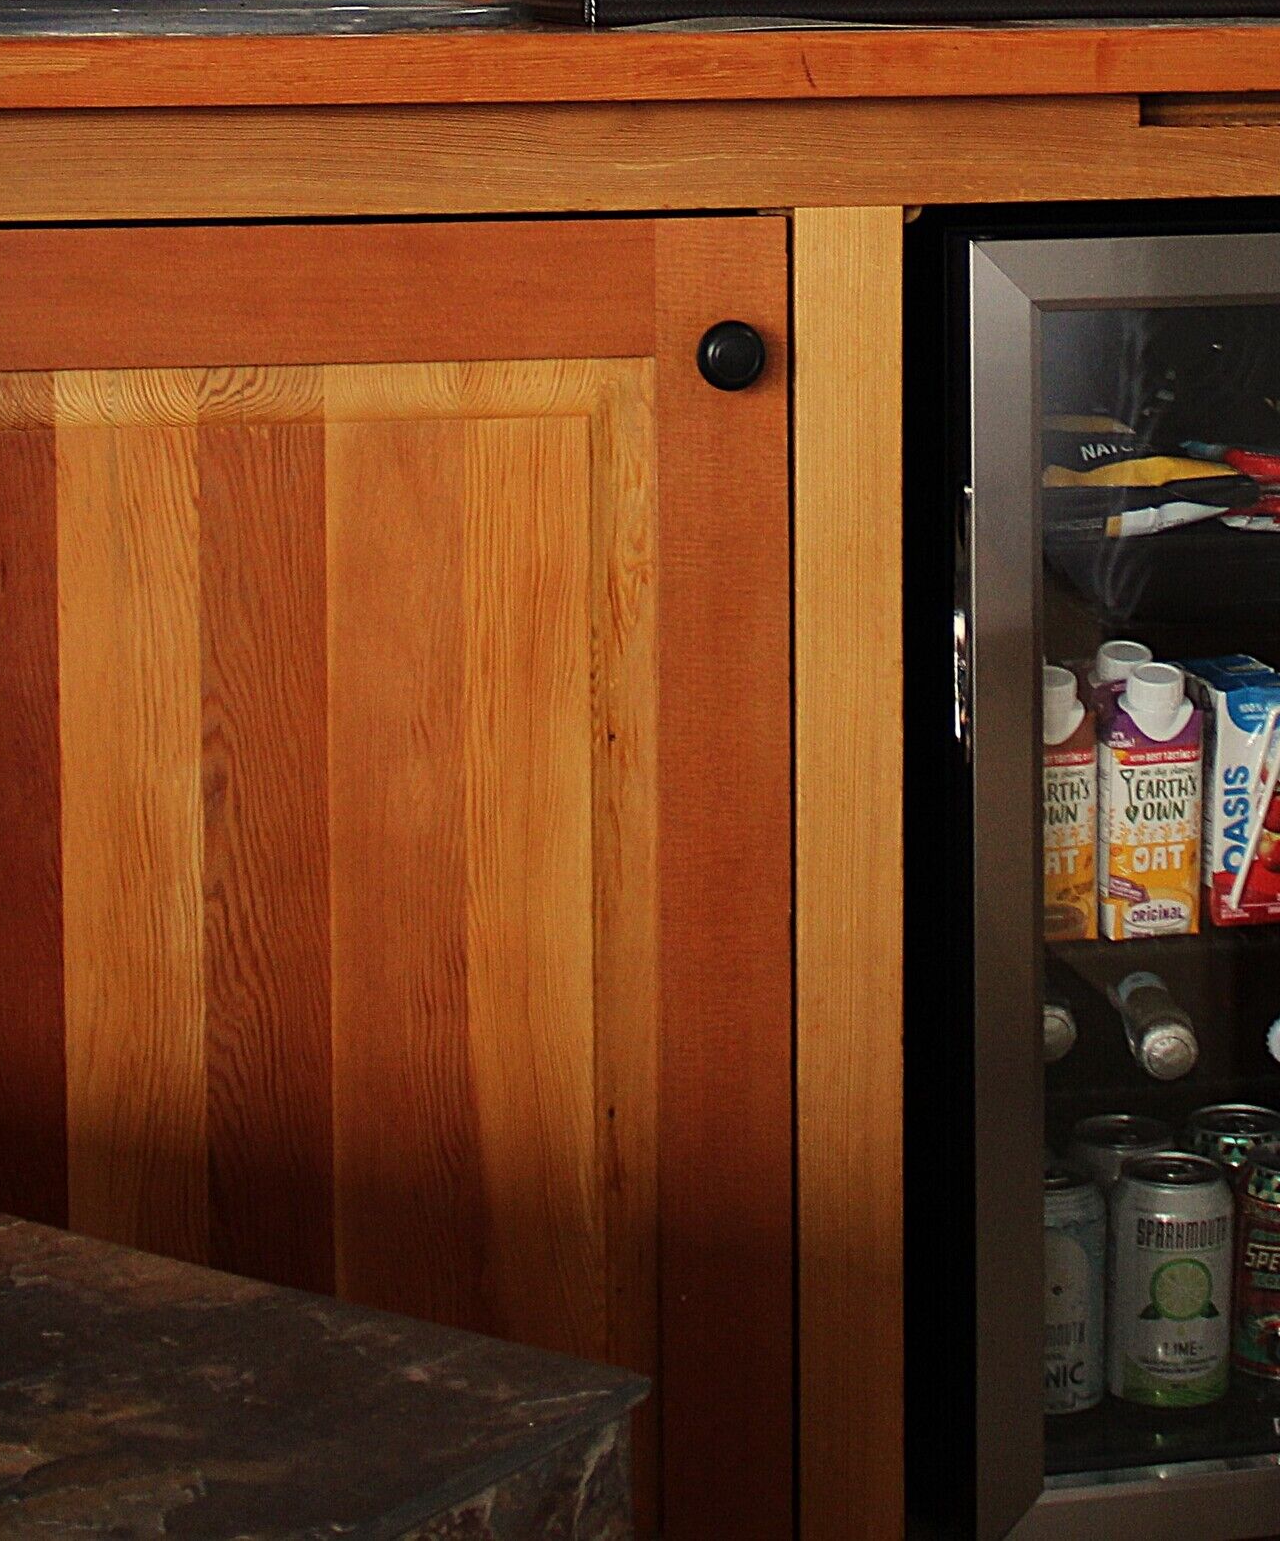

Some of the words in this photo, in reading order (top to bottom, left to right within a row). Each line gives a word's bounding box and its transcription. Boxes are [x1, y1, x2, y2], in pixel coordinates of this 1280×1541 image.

[1045, 777, 1089, 804] RTH'S
[1045, 802, 1078, 826] WN
[1143, 799, 1186, 821] OWN
[1223, 764, 1250, 875] OASIS
[1044, 848, 1080, 875] AT
[1131, 844, 1186, 873] OAT
[1045, 1361, 1085, 1389] NIC
